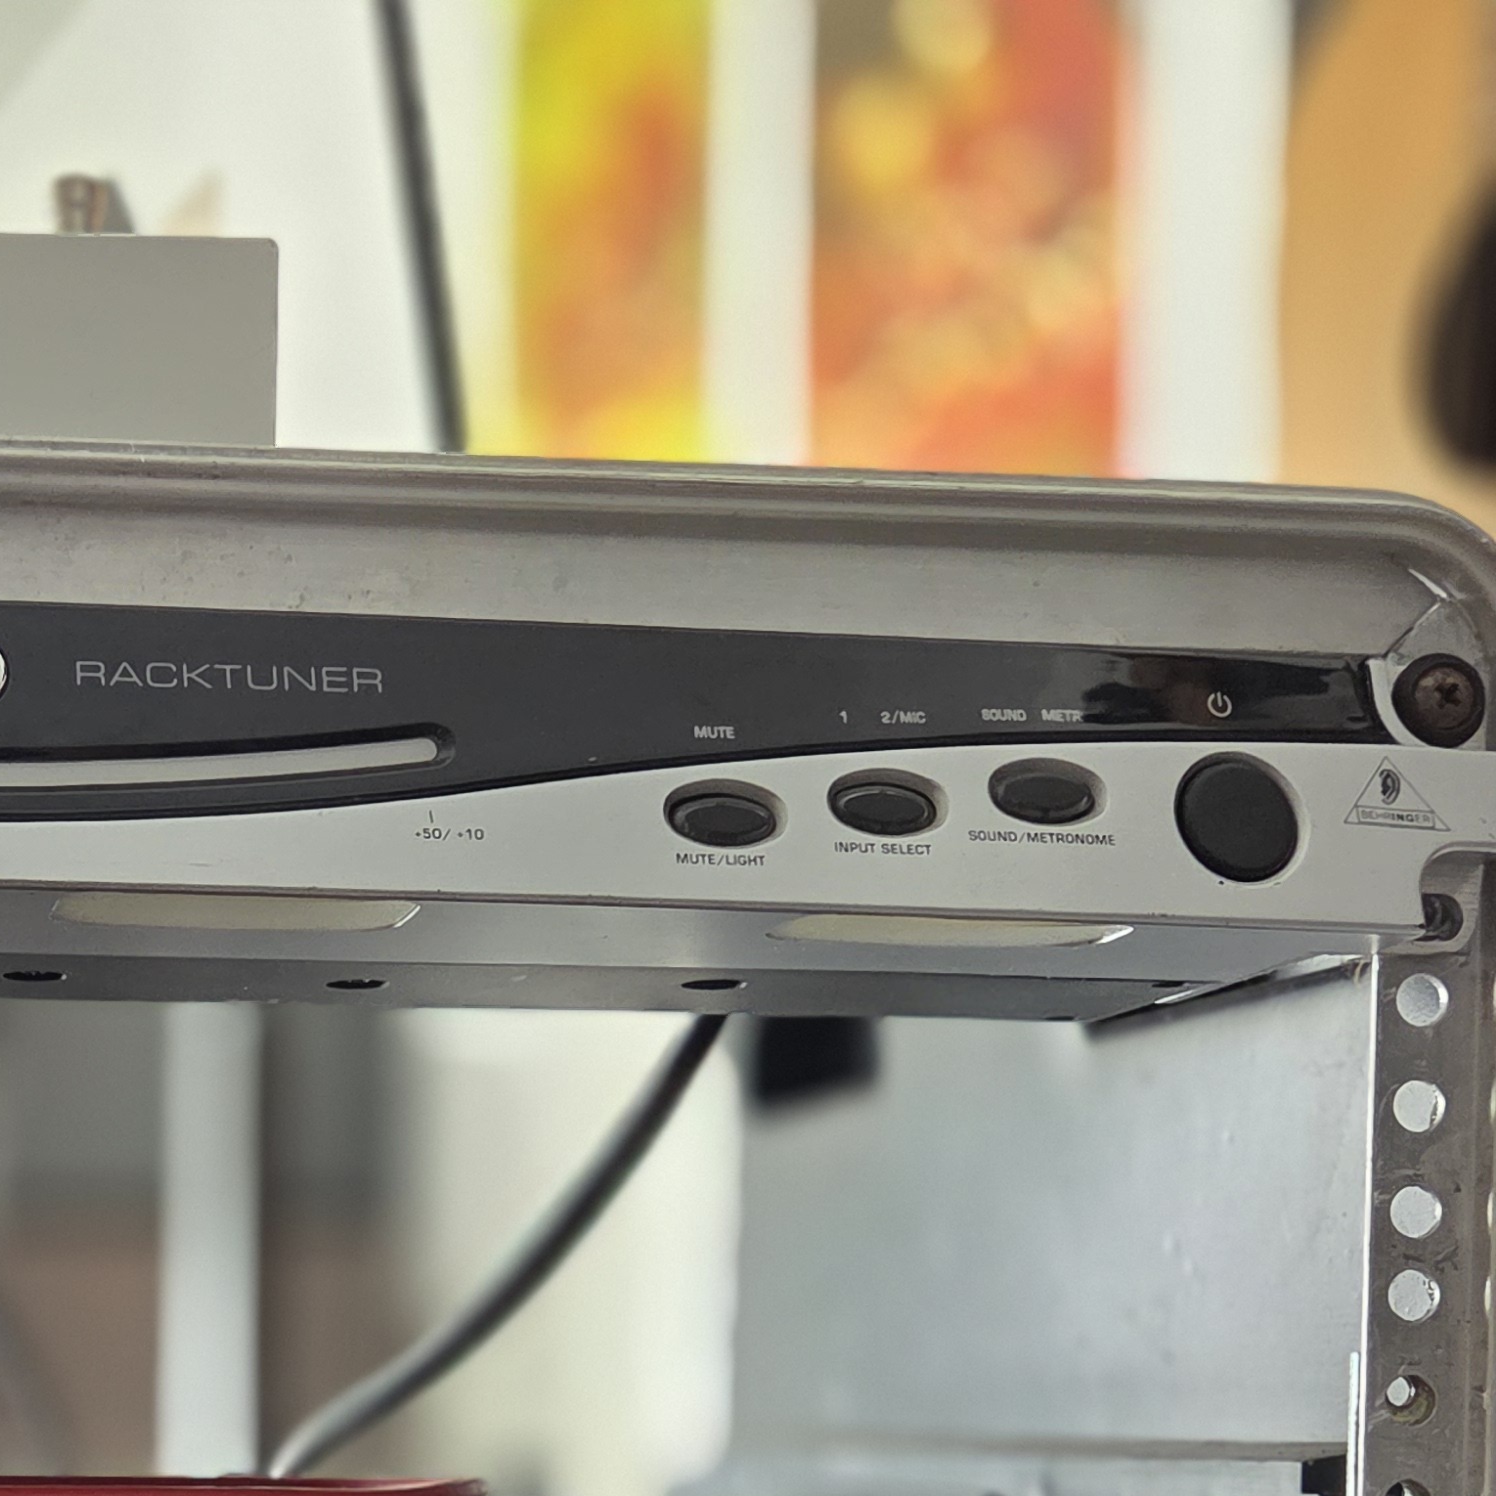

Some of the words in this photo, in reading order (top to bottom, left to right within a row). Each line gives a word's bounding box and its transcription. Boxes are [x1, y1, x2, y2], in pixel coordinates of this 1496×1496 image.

[75, 660, 384, 694] RACKTUNER
[839, 710, 848, 723] 1
[880, 710, 927, 724] 2/MIC
[981, 708, 1027, 721] SOUND
[694, 725, 735, 739] MUTE
[1361, 810, 1430, 824] BEHRINGER
[968, 829, 1116, 846] SOUND/METRONOME
[834, 842, 875, 855] INPUT
[881, 842, 932, 856] SELECT
[675, 853, 765, 867] MUTE/LIGHT
